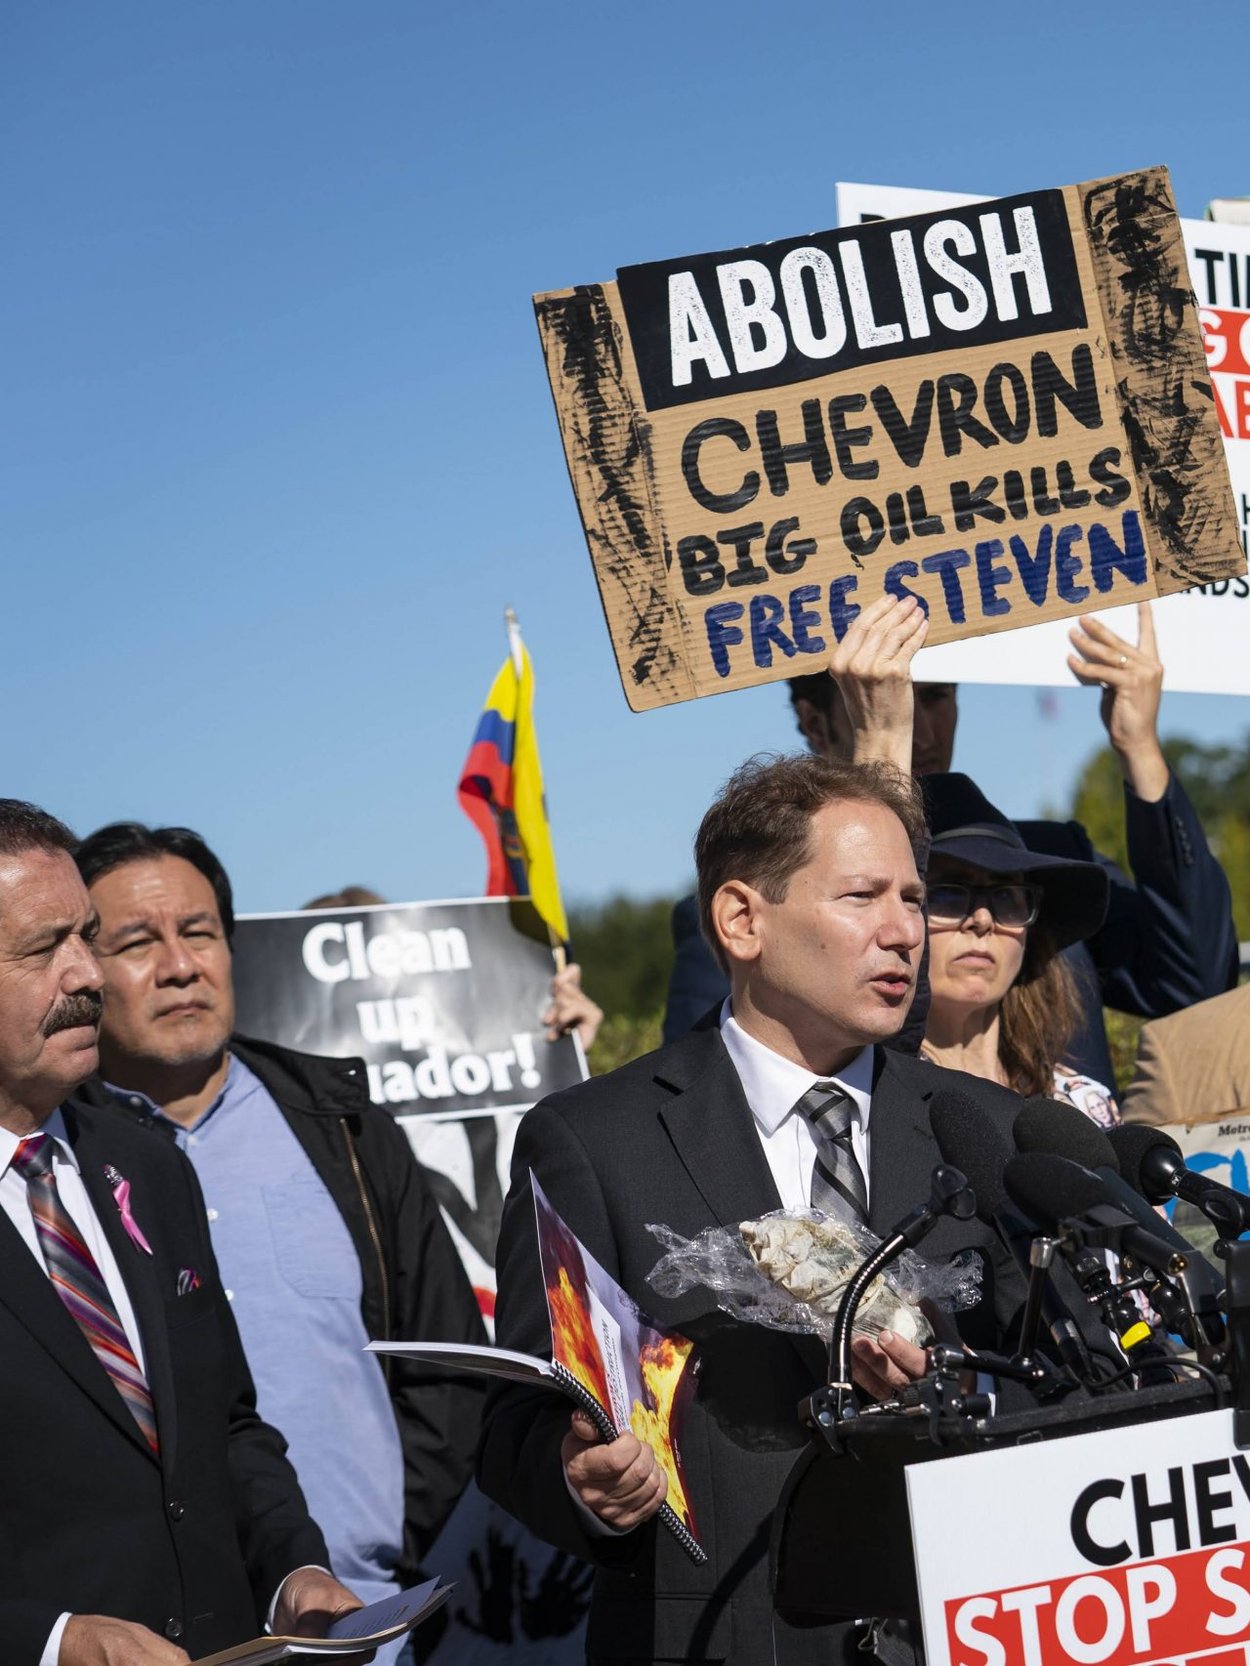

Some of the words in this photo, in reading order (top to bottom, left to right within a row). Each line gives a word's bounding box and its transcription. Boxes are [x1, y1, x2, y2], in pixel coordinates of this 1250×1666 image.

[668, 205, 1053, 387] ABOLISH
[681, 343, 1104, 514] CHEVRON
[677, 516, 818, 597] BIG
[840, 483, 944, 557] OIL
[950, 446, 1132, 532] KILLS
[705, 575, 861, 678] FREE
[884, 510, 1148, 624] STEVEN
[301, 919, 473, 984] Clean
[356, 995, 440, 1051] up
[953, 1563, 1177, 1666] STOP
